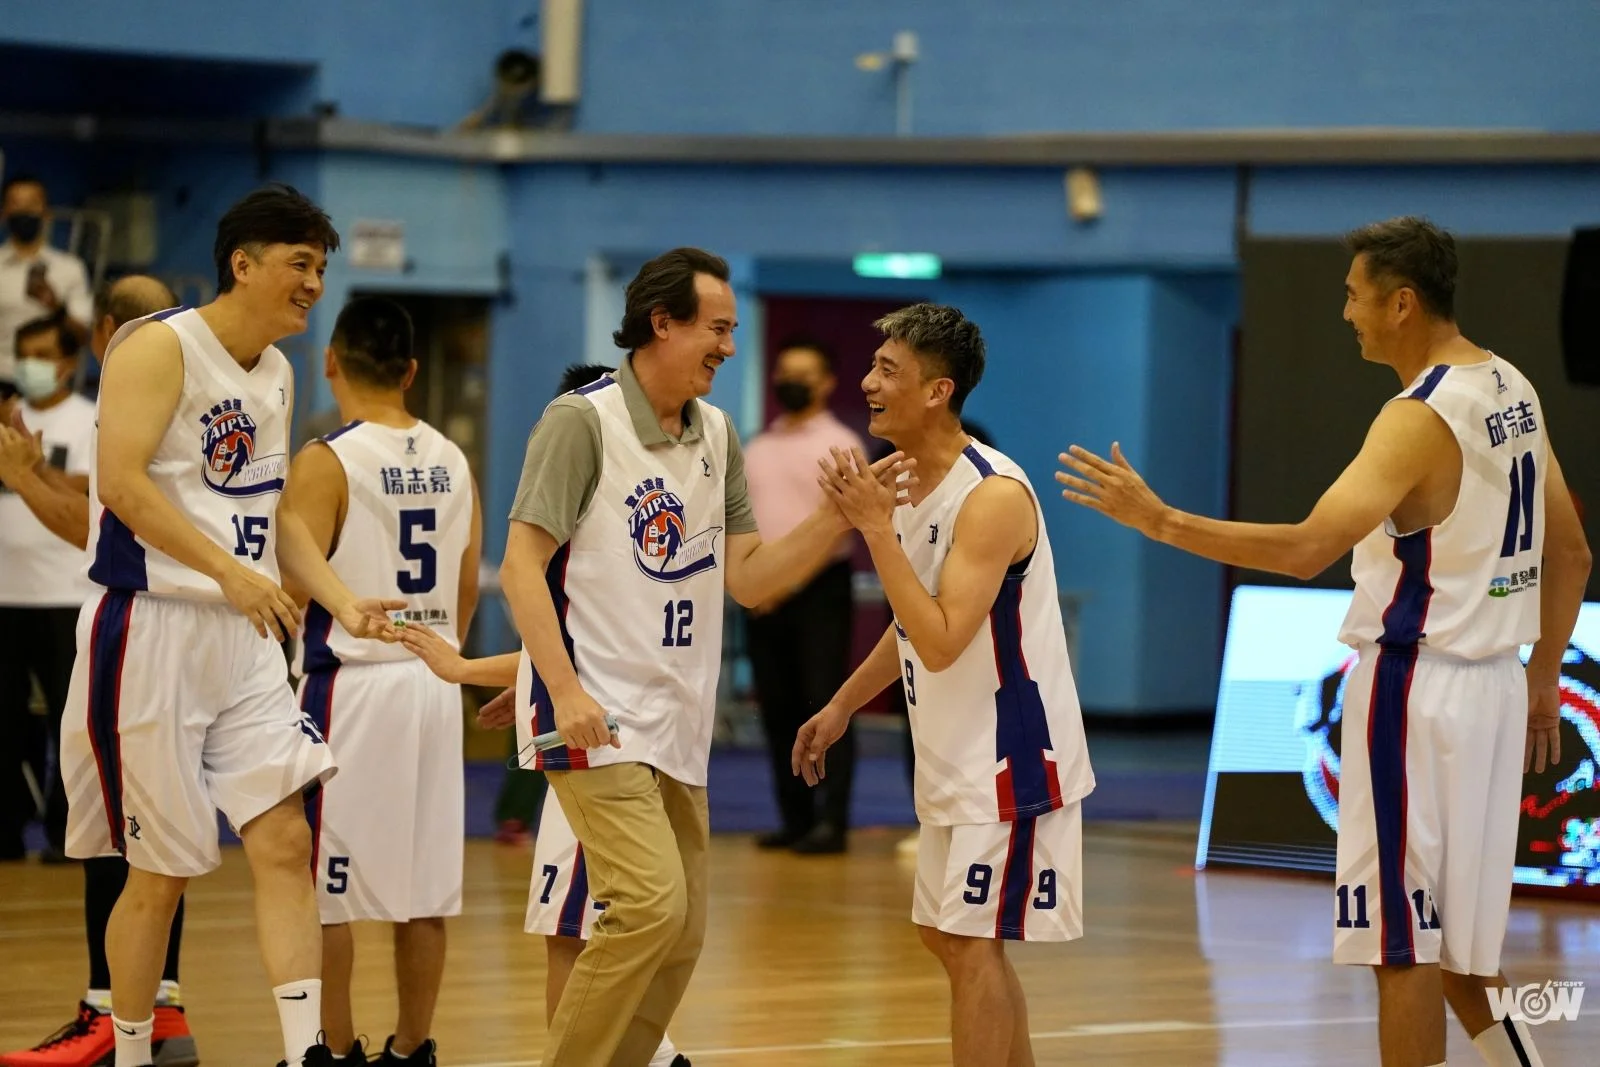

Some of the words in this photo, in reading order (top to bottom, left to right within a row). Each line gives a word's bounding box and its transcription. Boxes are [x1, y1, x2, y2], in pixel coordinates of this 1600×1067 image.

[203, 414, 256, 452] TAIPEI
[380, 466, 451, 496] 楊志豪
[630, 493, 683, 536] TAIPEI
[1500, 451, 1536, 558] 11
[232, 513, 269, 561] 15
[397, 508, 437, 594] 5
[662, 600, 694, 646] 12
[904, 659, 916, 706] 9
[326, 857, 349, 894] 5
[540, 864, 558, 904] 7
[963, 863, 993, 905] 9
[1033, 868, 1057, 910] 9
[1336, 884, 1370, 929] 11
